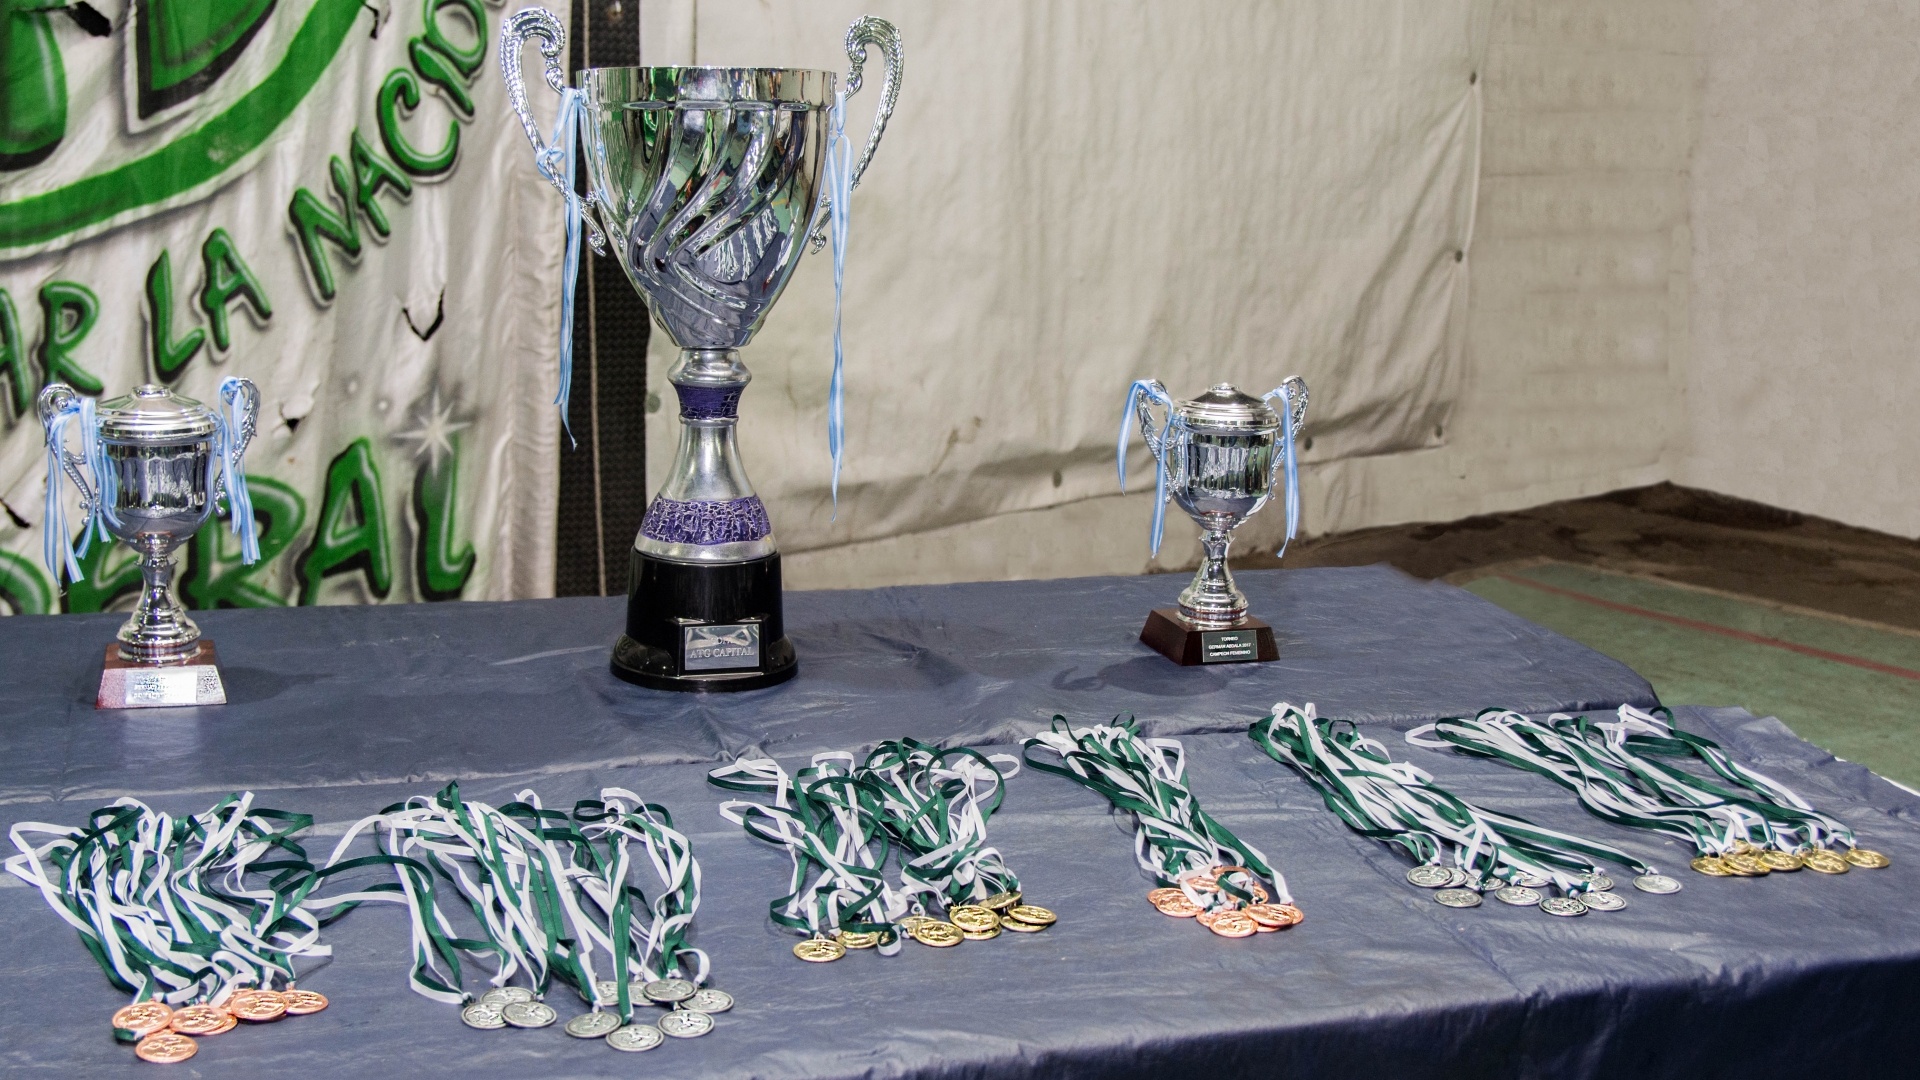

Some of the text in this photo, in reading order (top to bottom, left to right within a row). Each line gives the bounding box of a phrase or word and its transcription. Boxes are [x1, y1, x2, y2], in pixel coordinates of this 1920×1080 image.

[146, 228, 272, 380] LA
[289, 0, 490, 301] NACIO
[689, 646, 755, 659] ATG CAPITAL
